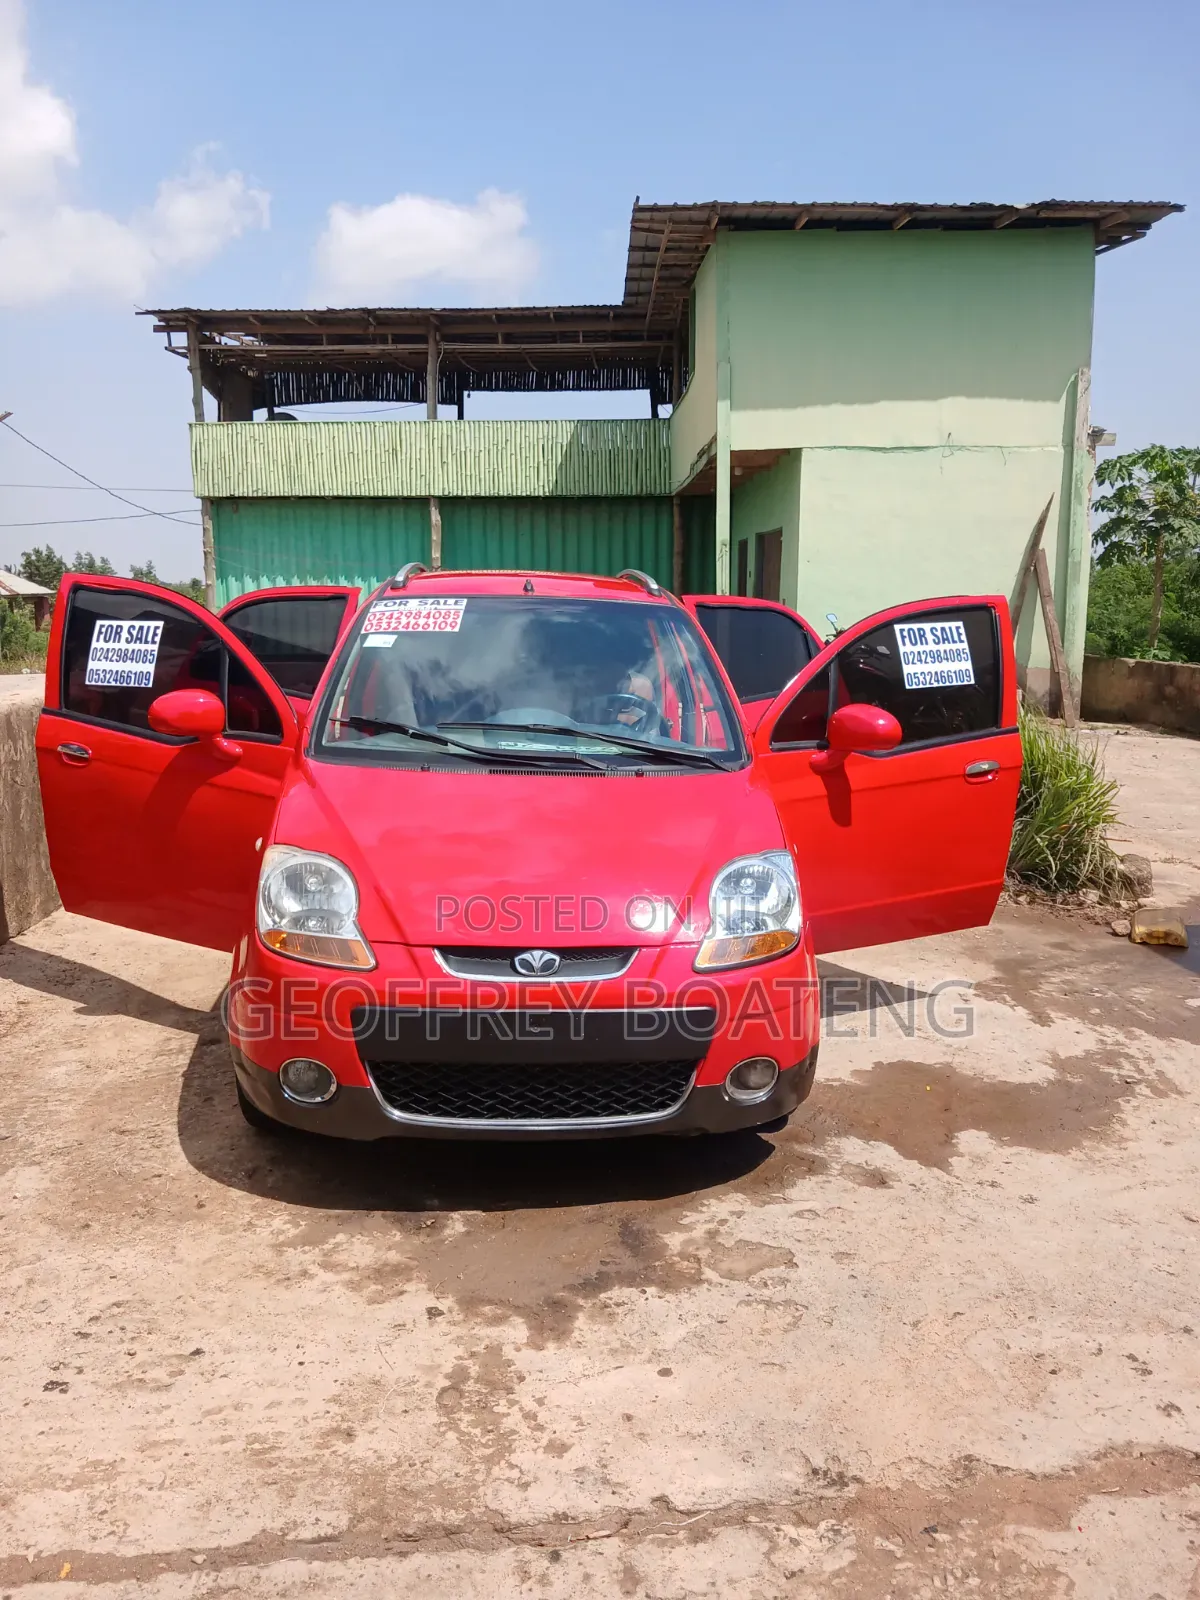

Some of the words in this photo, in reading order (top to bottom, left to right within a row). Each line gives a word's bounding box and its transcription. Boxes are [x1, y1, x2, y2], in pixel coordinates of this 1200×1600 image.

[372, 600, 410, 609] FOR
[417, 599, 465, 607] SALE
[367, 610, 461, 623] 0242984085
[96, 624, 123, 644] FOR
[125, 625, 161, 645] SALE
[363, 620, 459, 632] 0532466109
[899, 627, 929, 647] FOR
[929, 626, 965, 646] SALE
[91, 647, 156, 664] 0242984085
[902, 648, 969, 666] 0242984085
[87, 668, 152, 686] 0532466109
[906, 668, 972, 687] 0532466109
